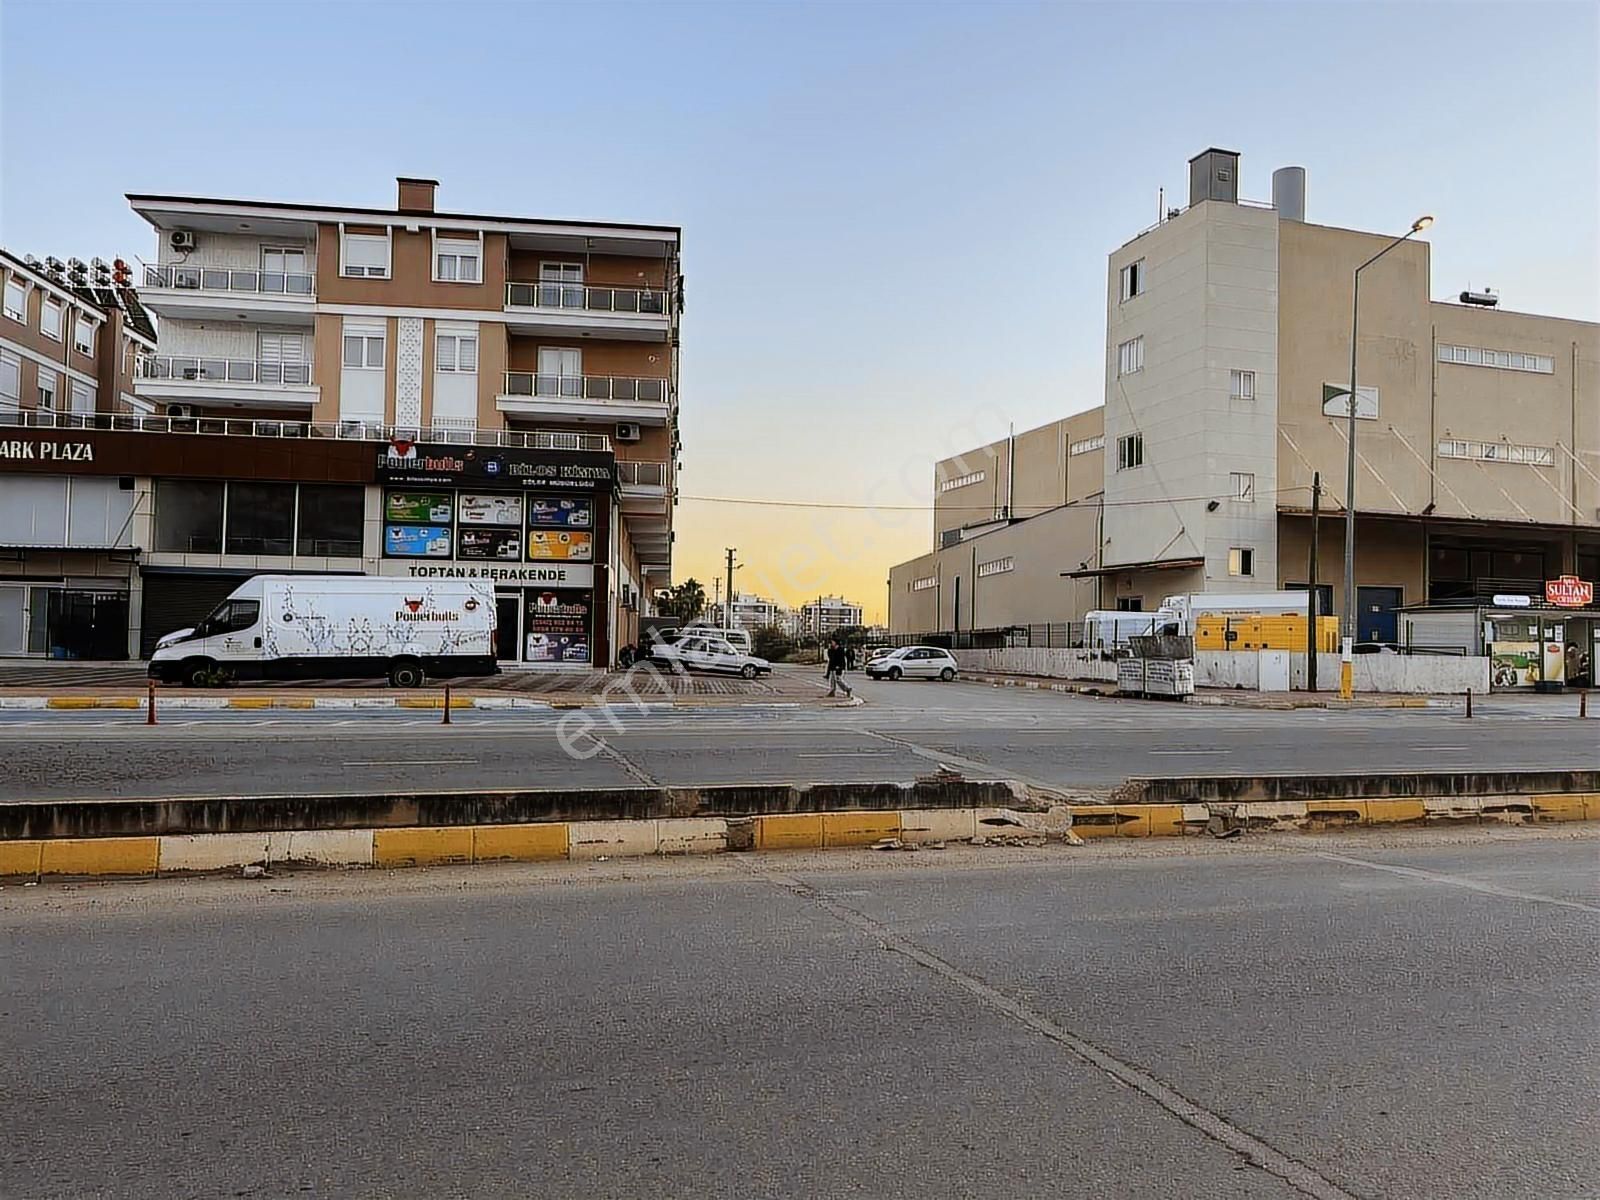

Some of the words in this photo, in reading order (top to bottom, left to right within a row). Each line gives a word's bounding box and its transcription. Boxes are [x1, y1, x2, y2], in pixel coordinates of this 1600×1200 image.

[40, 442, 94, 461] PLAZA
[408, 566, 465, 578] TOPTAN
[468, 568, 478, 578] &
[481, 568, 566, 581] PERAKENDE
[1548, 584, 1590, 598] SULTAN
[395, 610, 460, 622] Powerbulls
